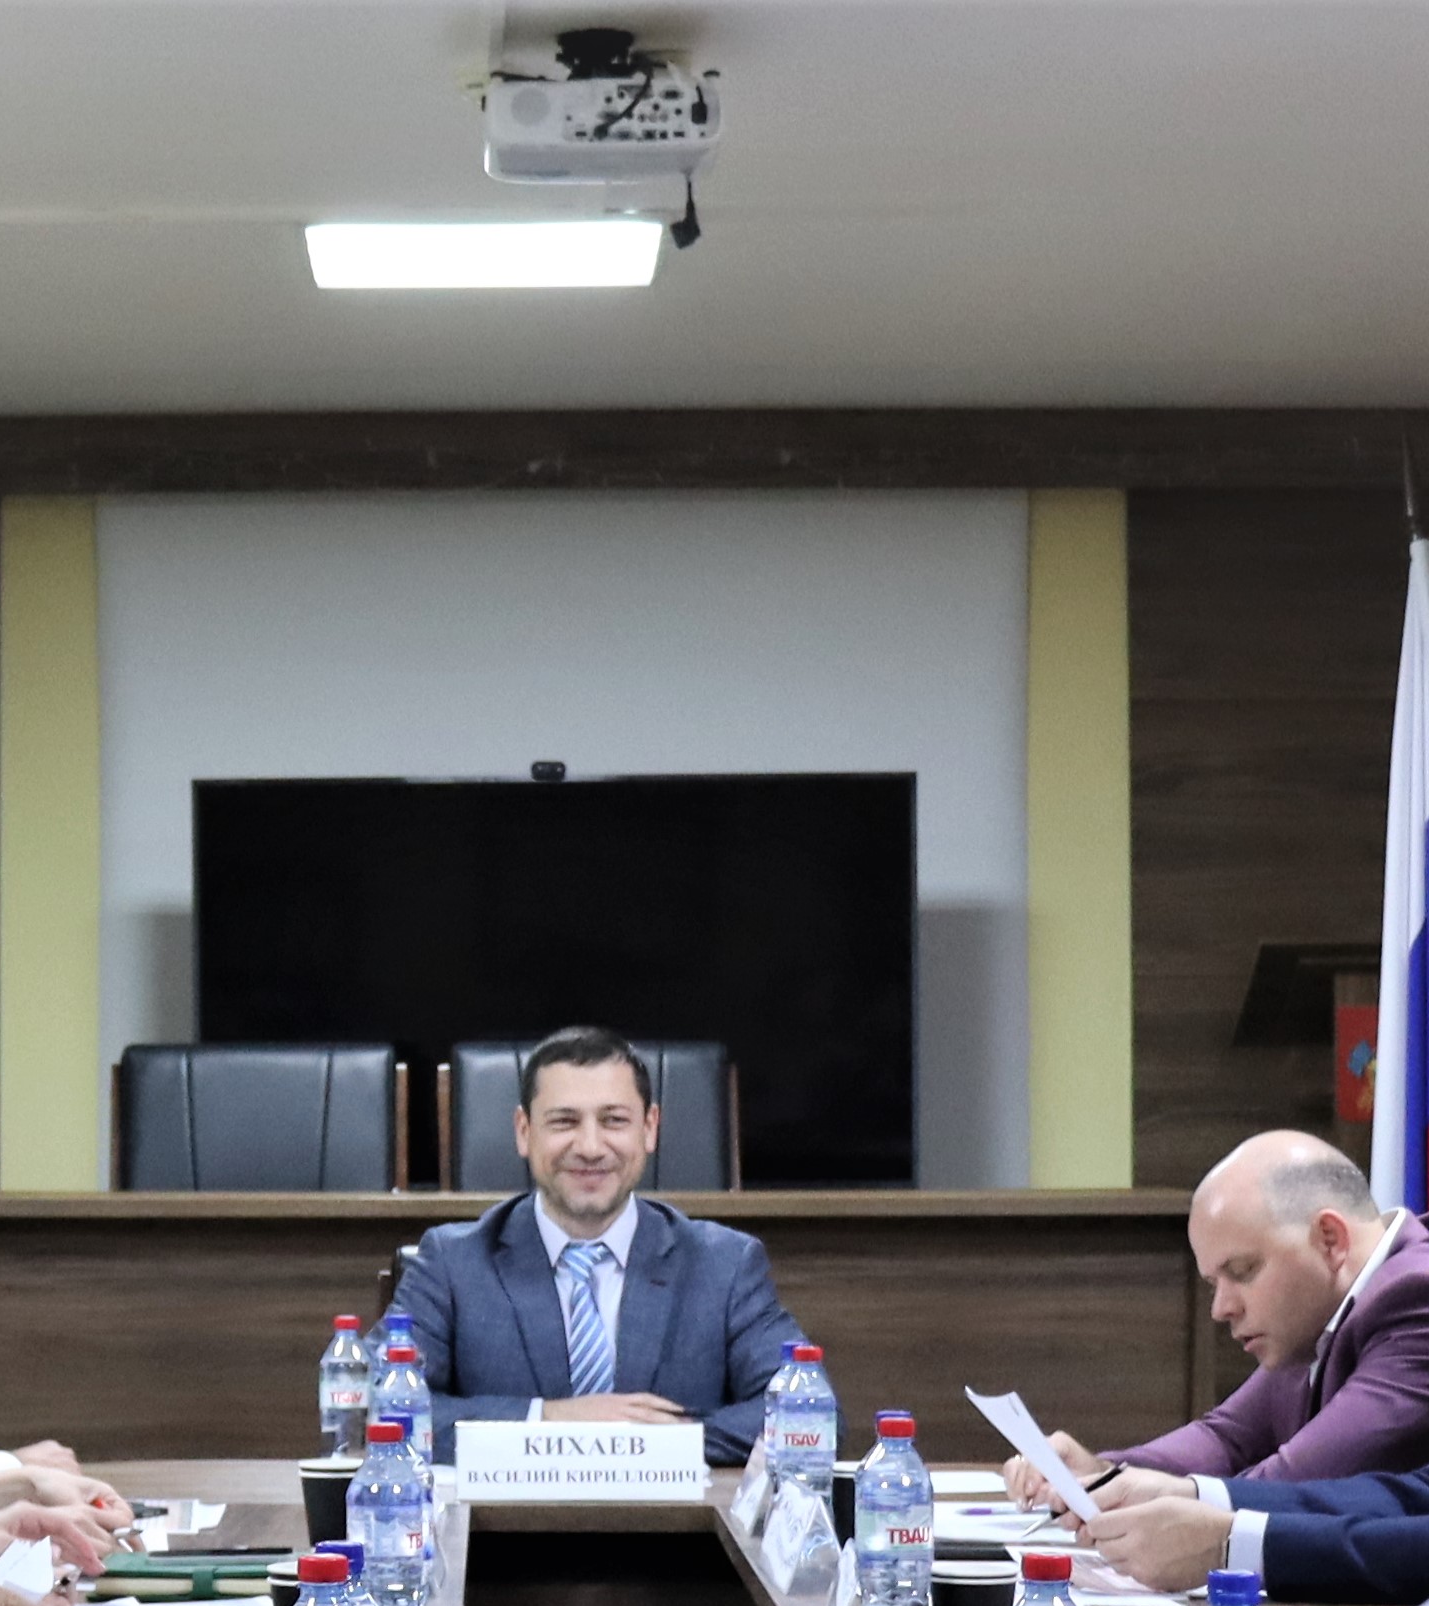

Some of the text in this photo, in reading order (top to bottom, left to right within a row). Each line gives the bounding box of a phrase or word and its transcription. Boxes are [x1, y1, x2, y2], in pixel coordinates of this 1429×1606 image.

[524, 1436, 646, 1456] КИХАЕВ
[468, 1467, 698, 1483] ВАСИЛИЙ КИРИЛЛОВИЧ
